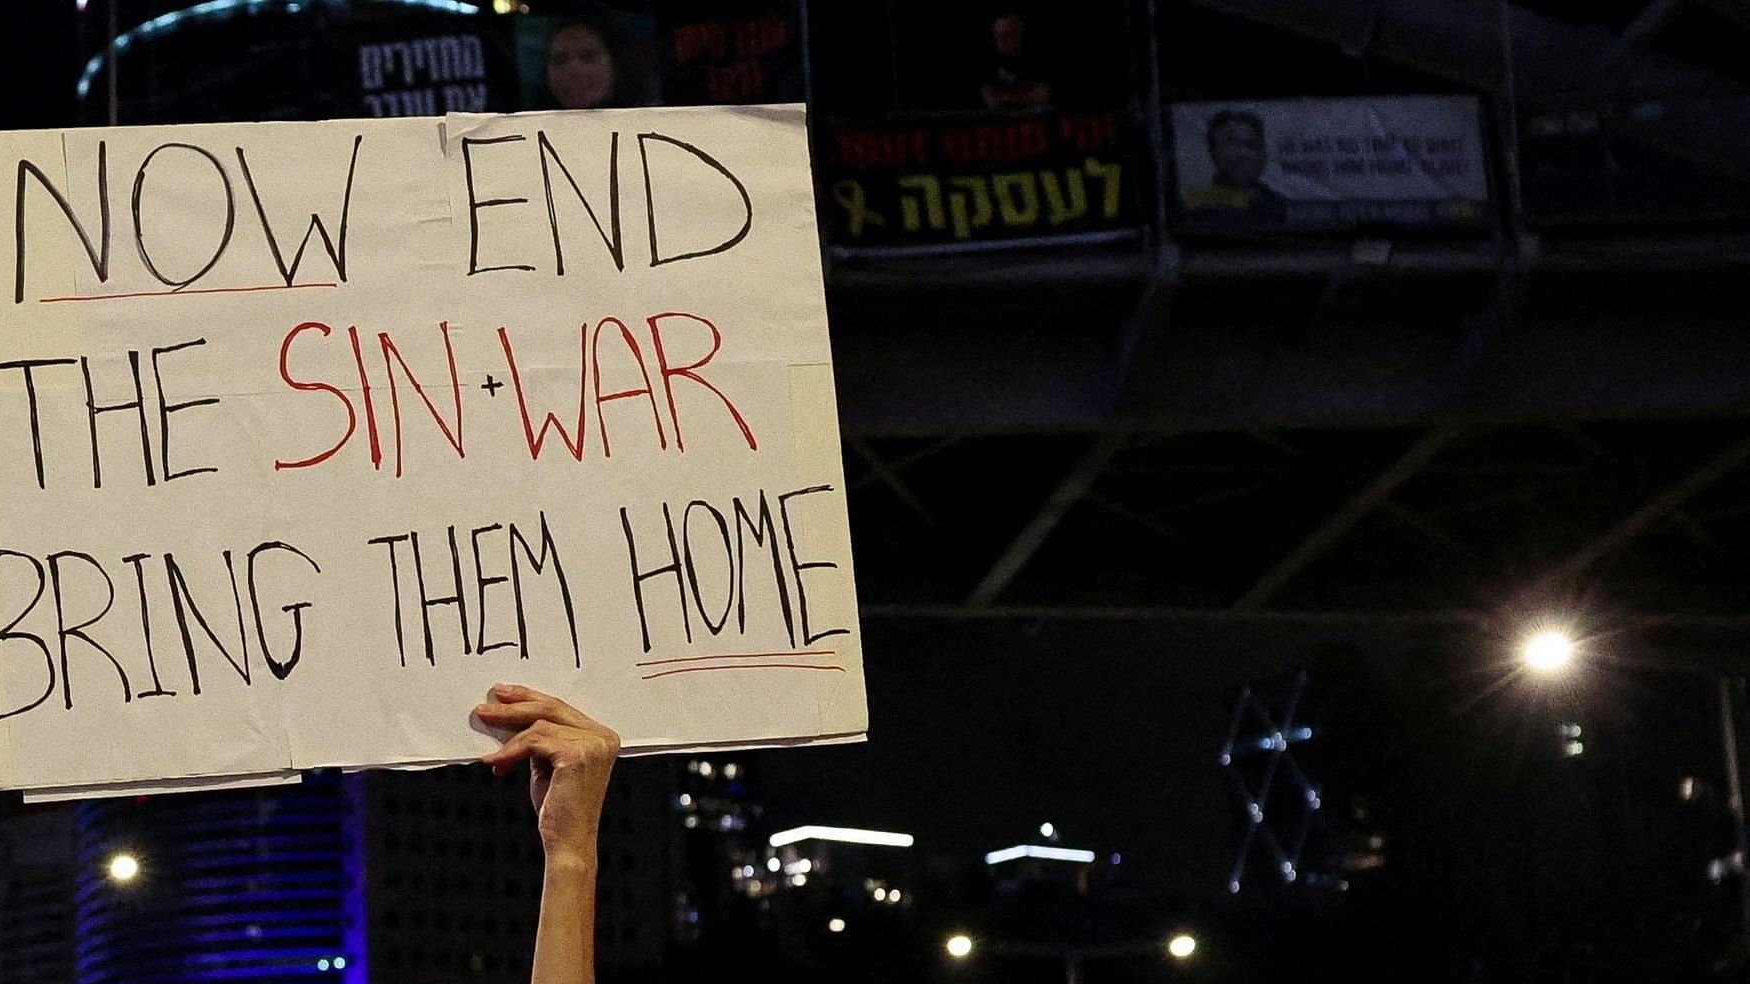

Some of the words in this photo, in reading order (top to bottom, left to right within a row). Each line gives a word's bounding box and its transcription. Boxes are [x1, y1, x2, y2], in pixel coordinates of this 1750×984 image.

[15, 134, 364, 304] NOW
[461, 130, 753, 277] END
[898, 157, 1122, 239] לעסקה
[367, 511, 583, 668] THEM
[619, 485, 850, 652] HOME
